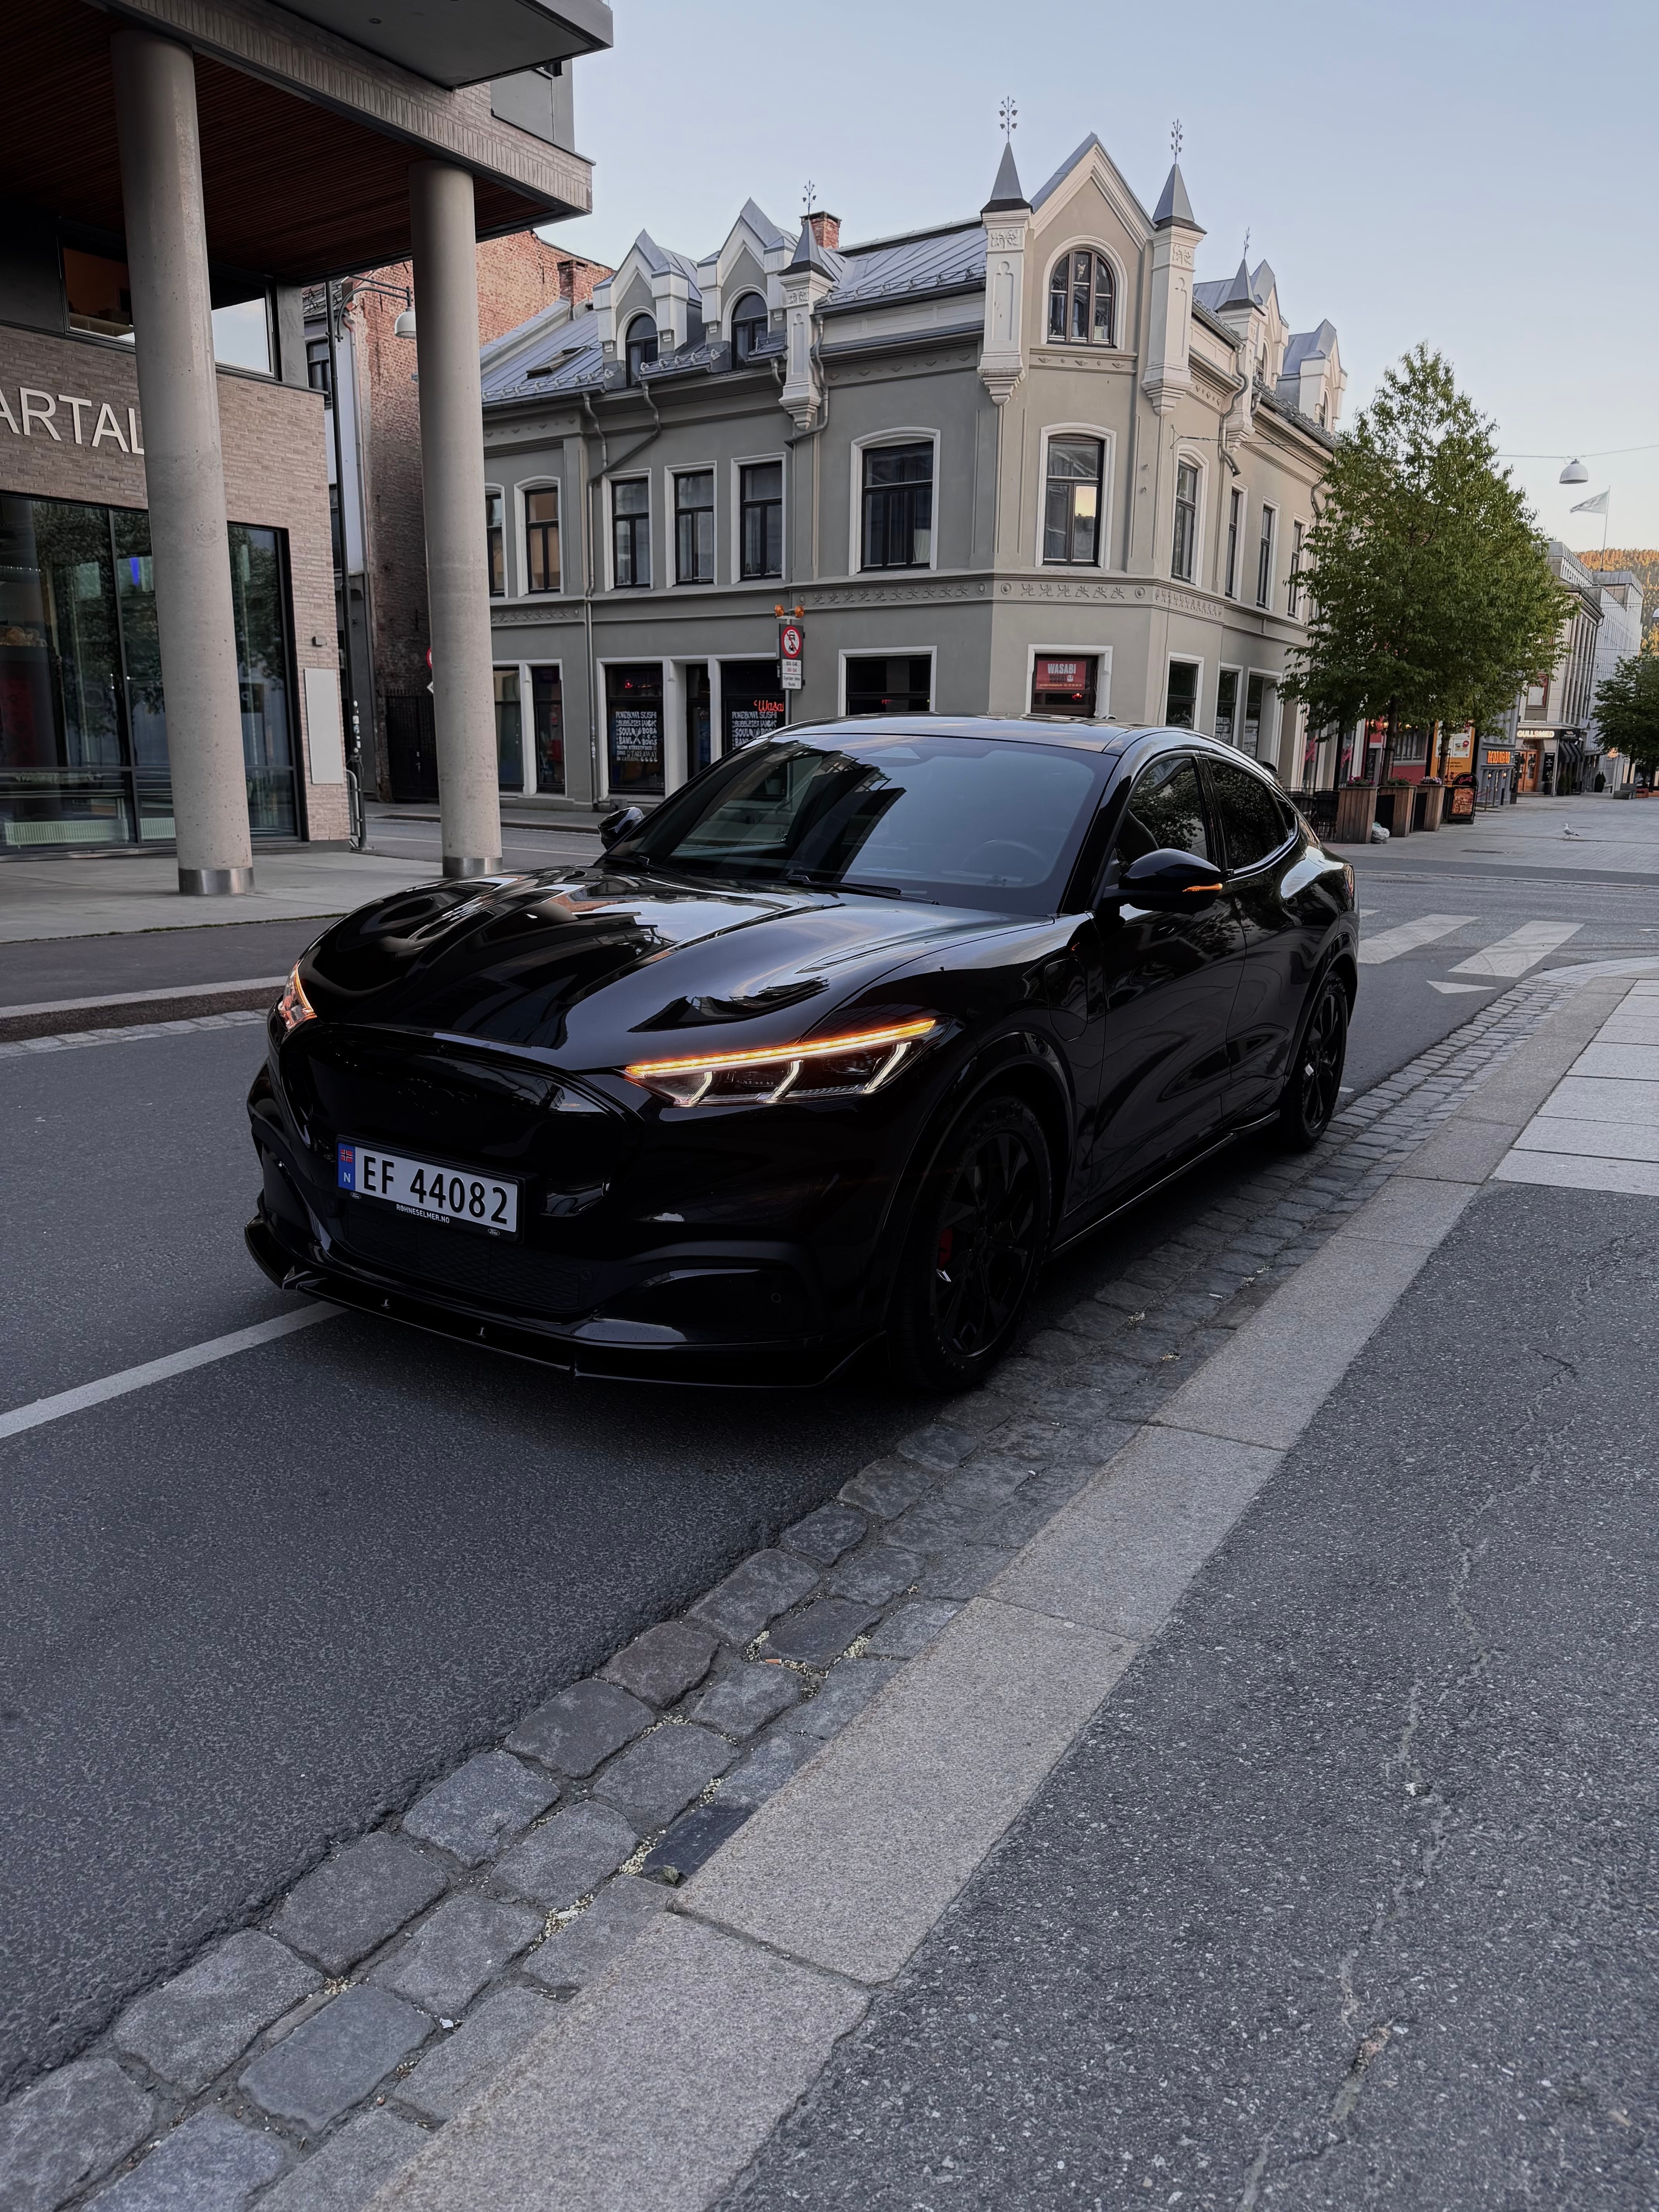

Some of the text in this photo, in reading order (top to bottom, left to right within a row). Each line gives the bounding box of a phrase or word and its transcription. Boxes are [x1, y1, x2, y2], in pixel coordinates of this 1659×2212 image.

[1048, 663, 1076, 674] WASABI
[758, 700, 784, 712] Wasa
[618, 727, 632, 736] SOUL
[735, 728, 750, 737] SOUL
[343, 1172, 351, 1183] N
[363, 1155, 507, 1225] EF 44082
[396, 1204, 450, 1224] RØHNESELMER.NO
